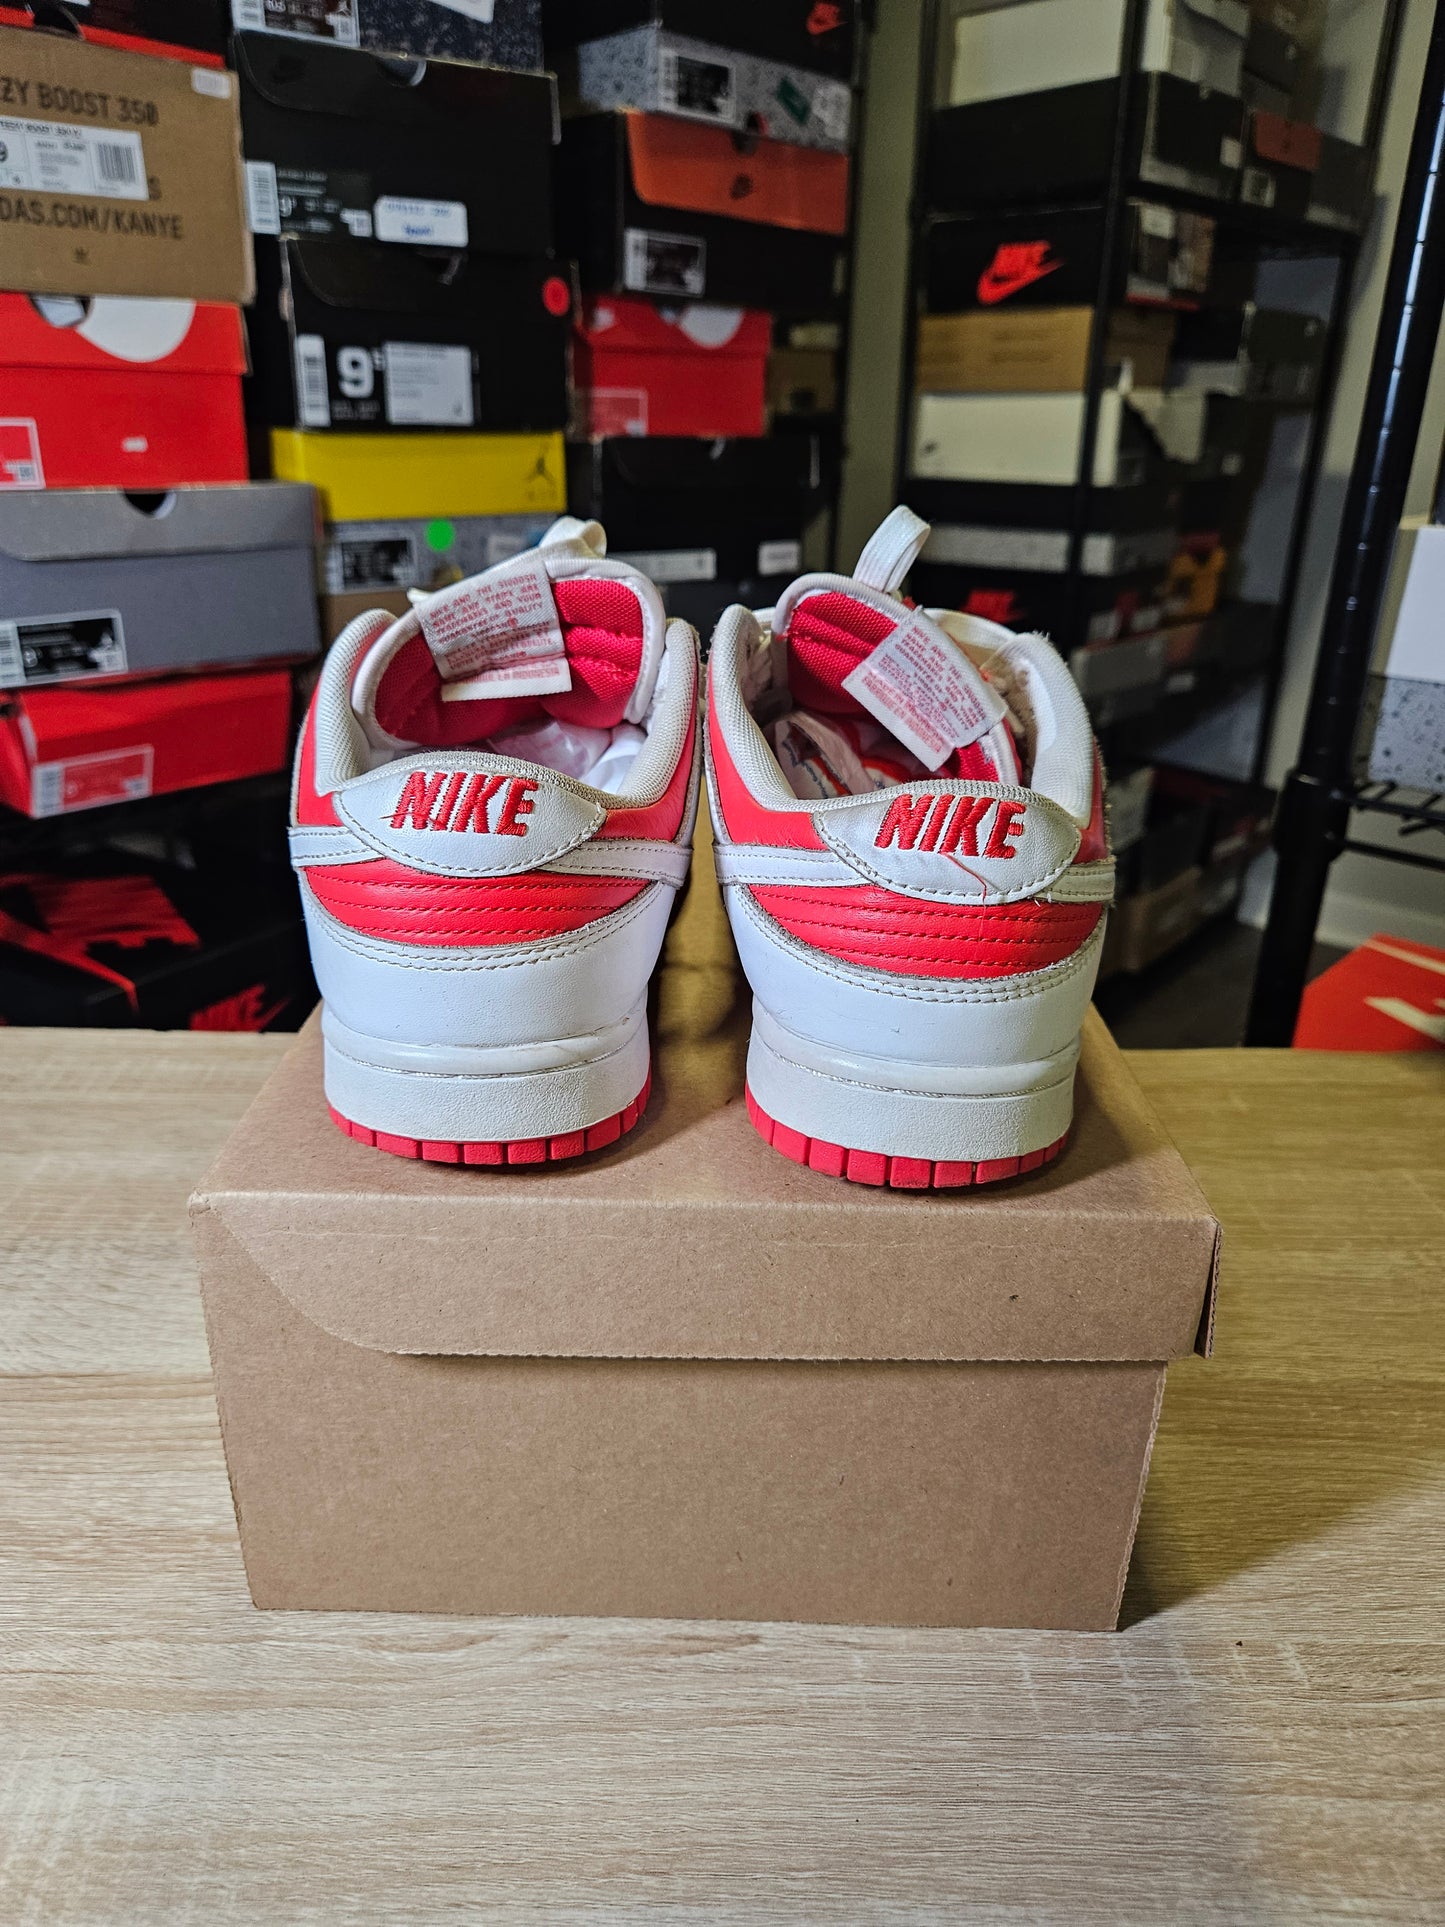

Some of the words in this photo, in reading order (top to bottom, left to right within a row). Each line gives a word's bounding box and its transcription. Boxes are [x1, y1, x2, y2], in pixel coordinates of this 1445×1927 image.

[38, 82, 109, 118] BOOST
[119, 96, 159, 127] 350
[389, 771, 539, 837] NIKE
[874, 793, 1026, 859] NIKE
